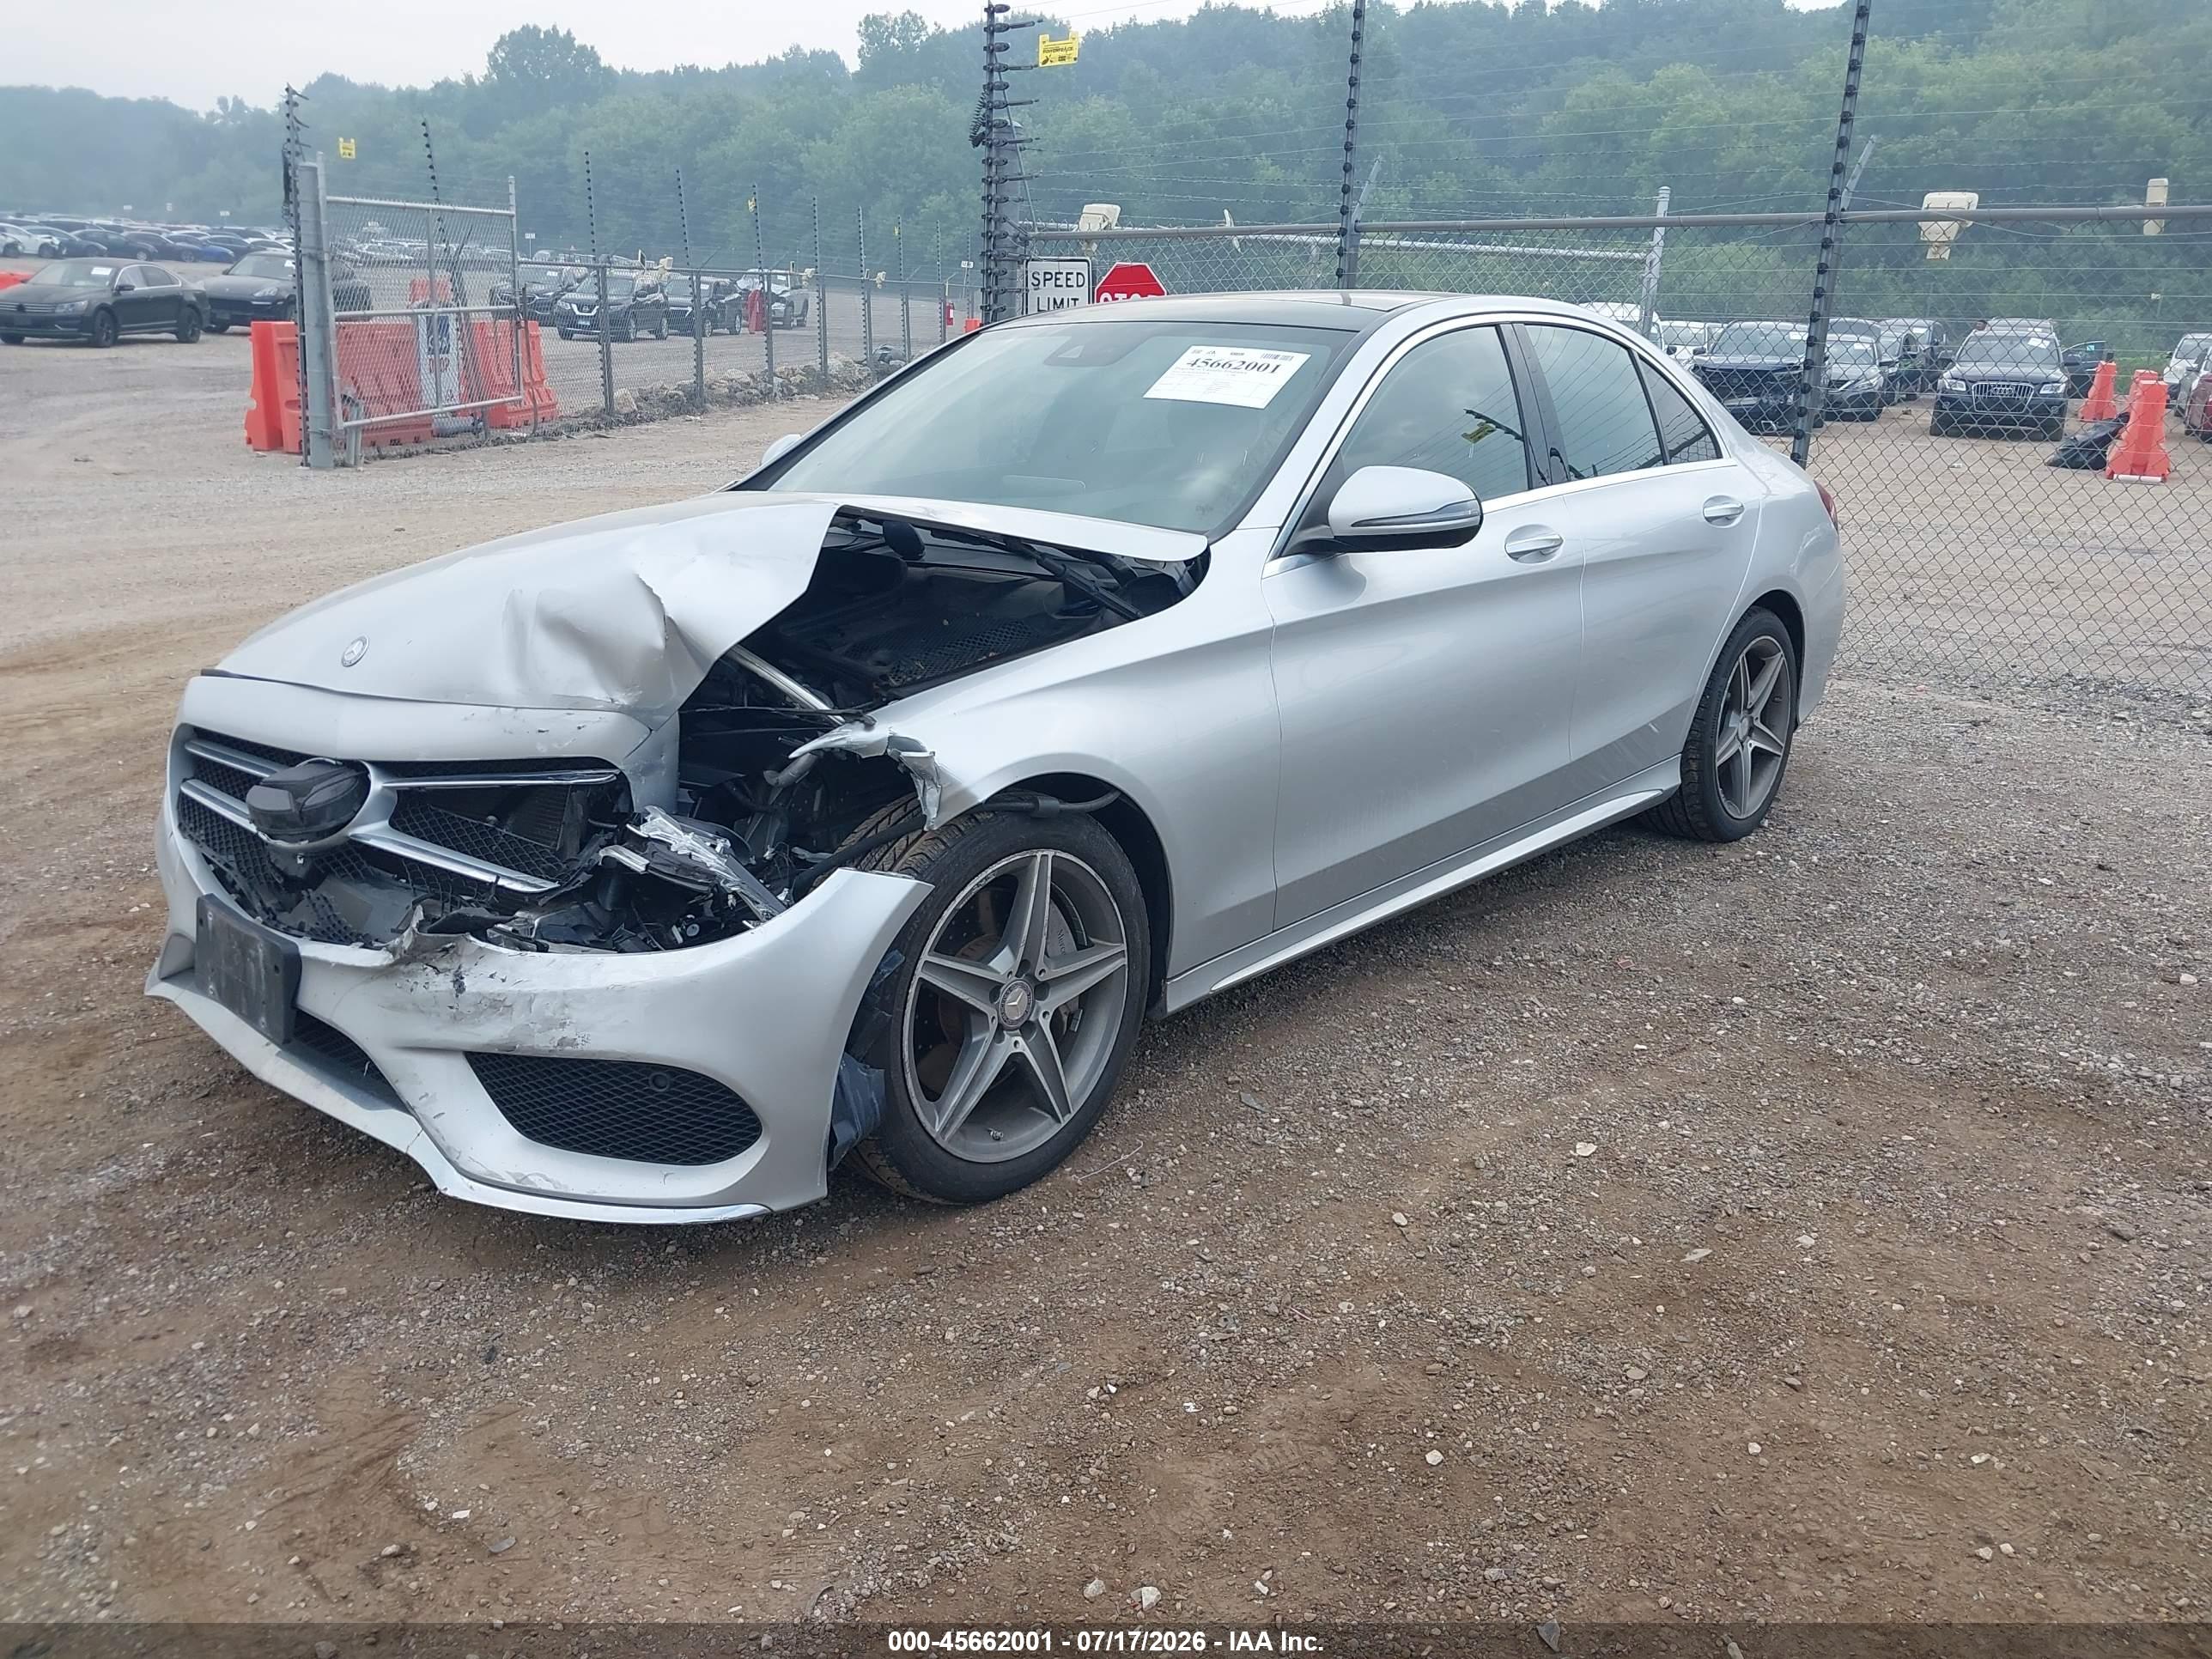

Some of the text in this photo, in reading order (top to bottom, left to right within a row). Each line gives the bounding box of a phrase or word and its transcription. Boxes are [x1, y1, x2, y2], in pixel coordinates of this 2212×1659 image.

[1030, 271, 1085, 288] SPEED
[1036, 296, 1080, 312] LIMIT
[1187, 357, 1282, 374] 45662001
